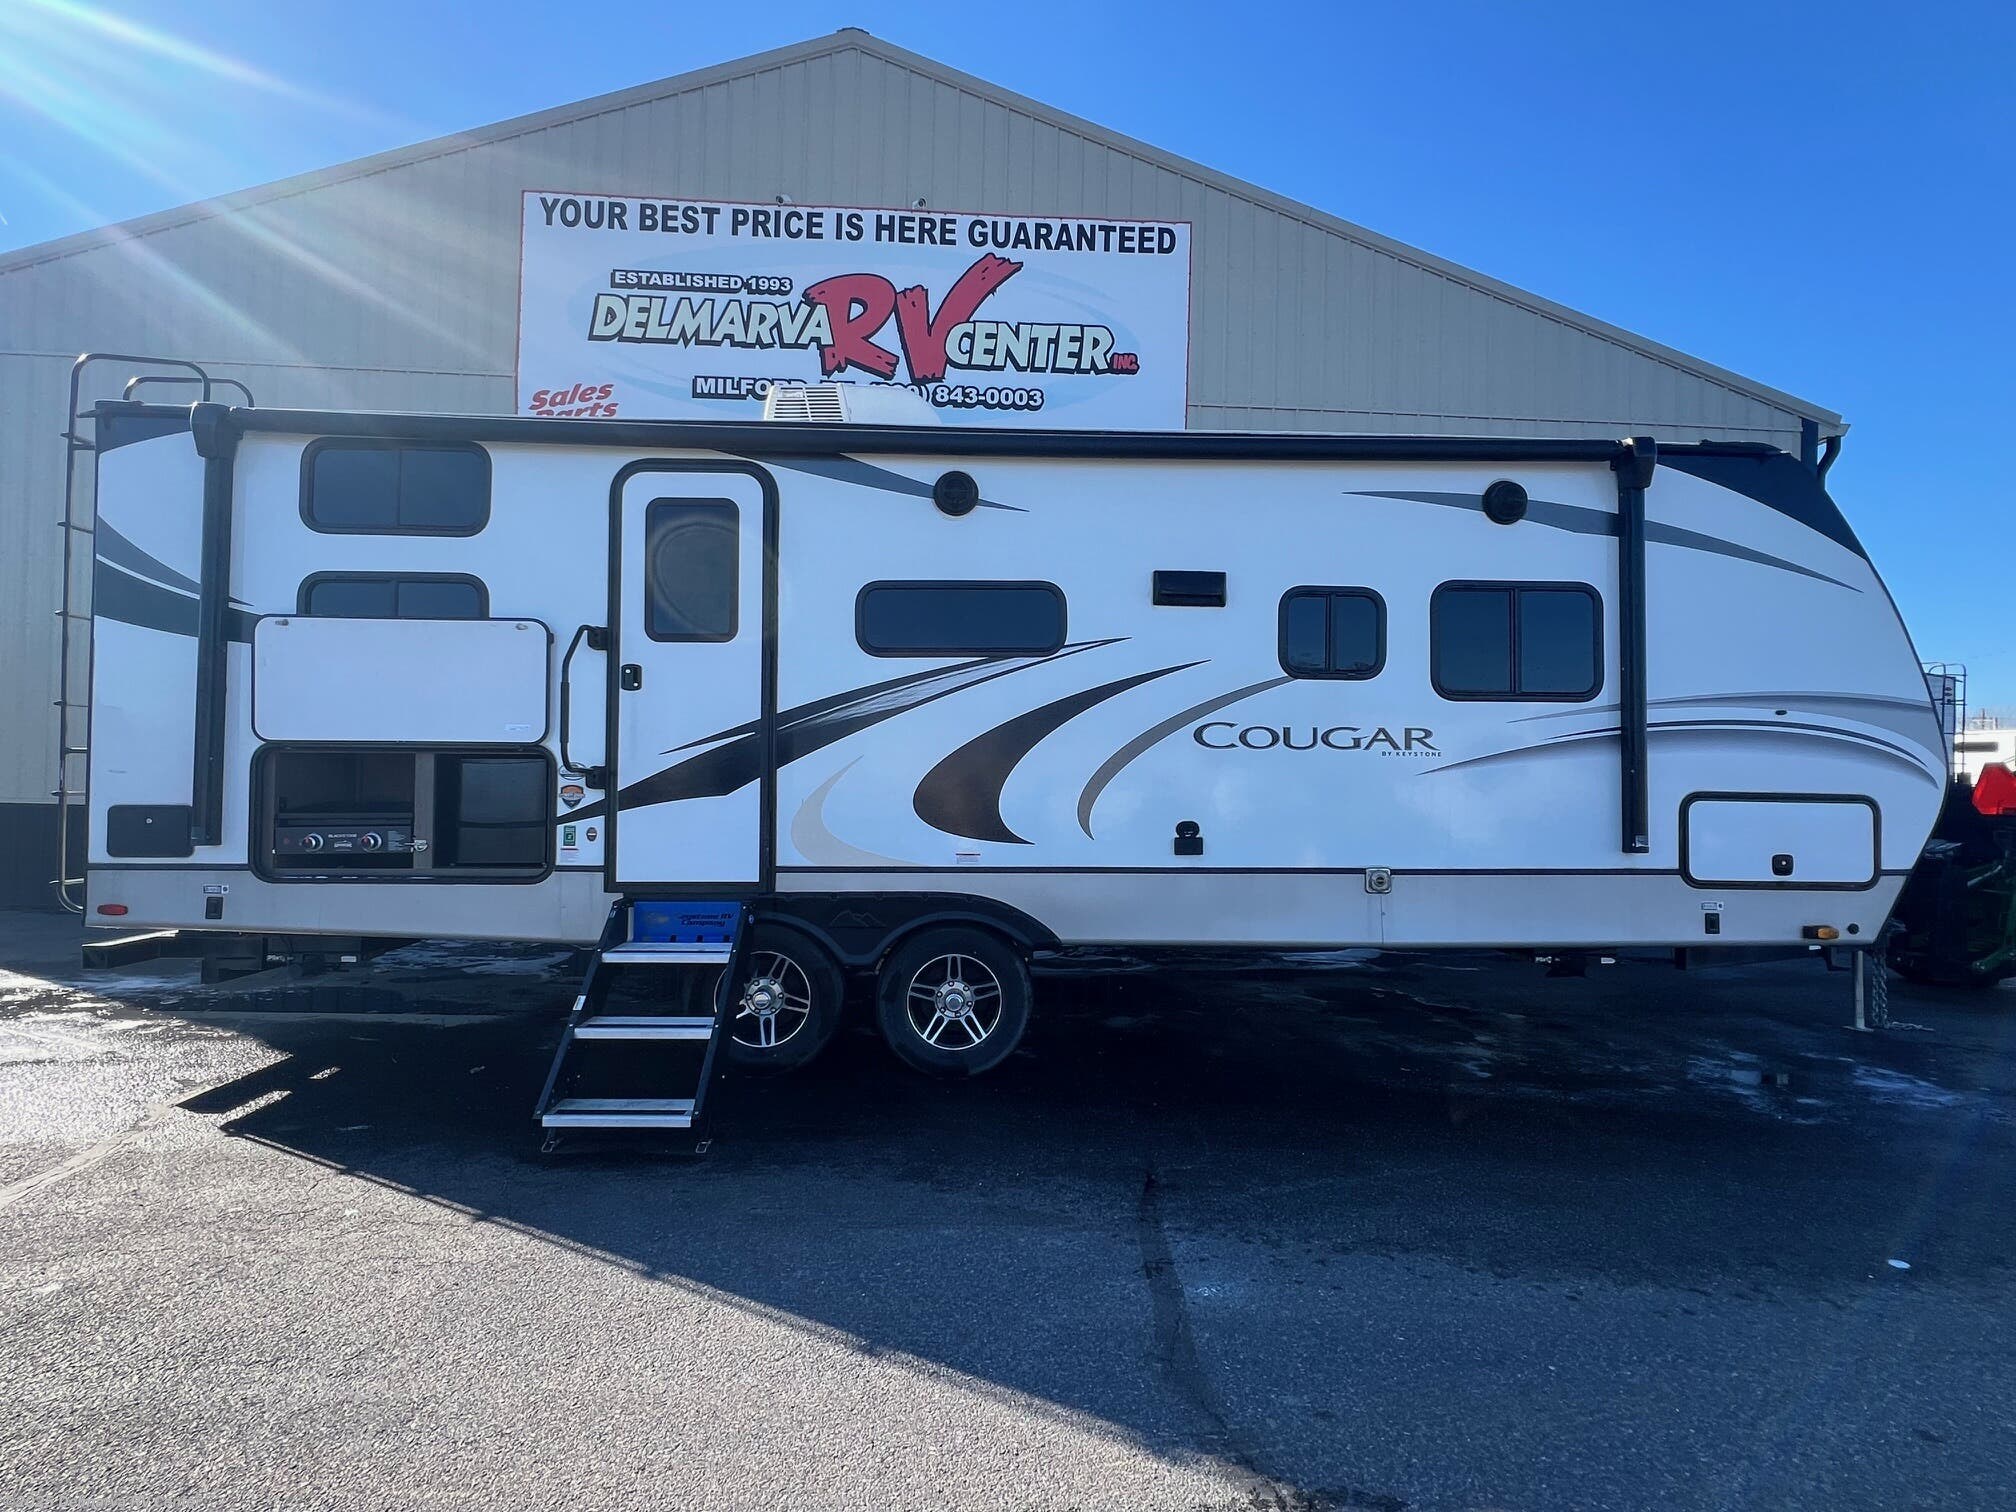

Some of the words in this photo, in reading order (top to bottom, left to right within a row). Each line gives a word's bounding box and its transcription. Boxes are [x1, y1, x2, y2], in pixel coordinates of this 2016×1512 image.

[540, 197, 628, 230] YOUR
[639, 203, 720, 235] BEST
[731, 208, 824, 240] PRICE
[835, 212, 864, 242] IS
[875, 215, 957, 246] HERE
[967, 219, 1177, 255] GUARANTEED
[613, 271, 743, 291] ESTABLISHED
[748, 276, 792, 292] 1993
[590, 294, 836, 347] DELMARVA
[801, 253, 1024, 382] RV
[944, 320, 1116, 373] CENTER
[695, 376, 806, 396] MILFO
[934, 386, 1044, 407] 843-0003
[1193, 722, 1441, 751] COUGAR
